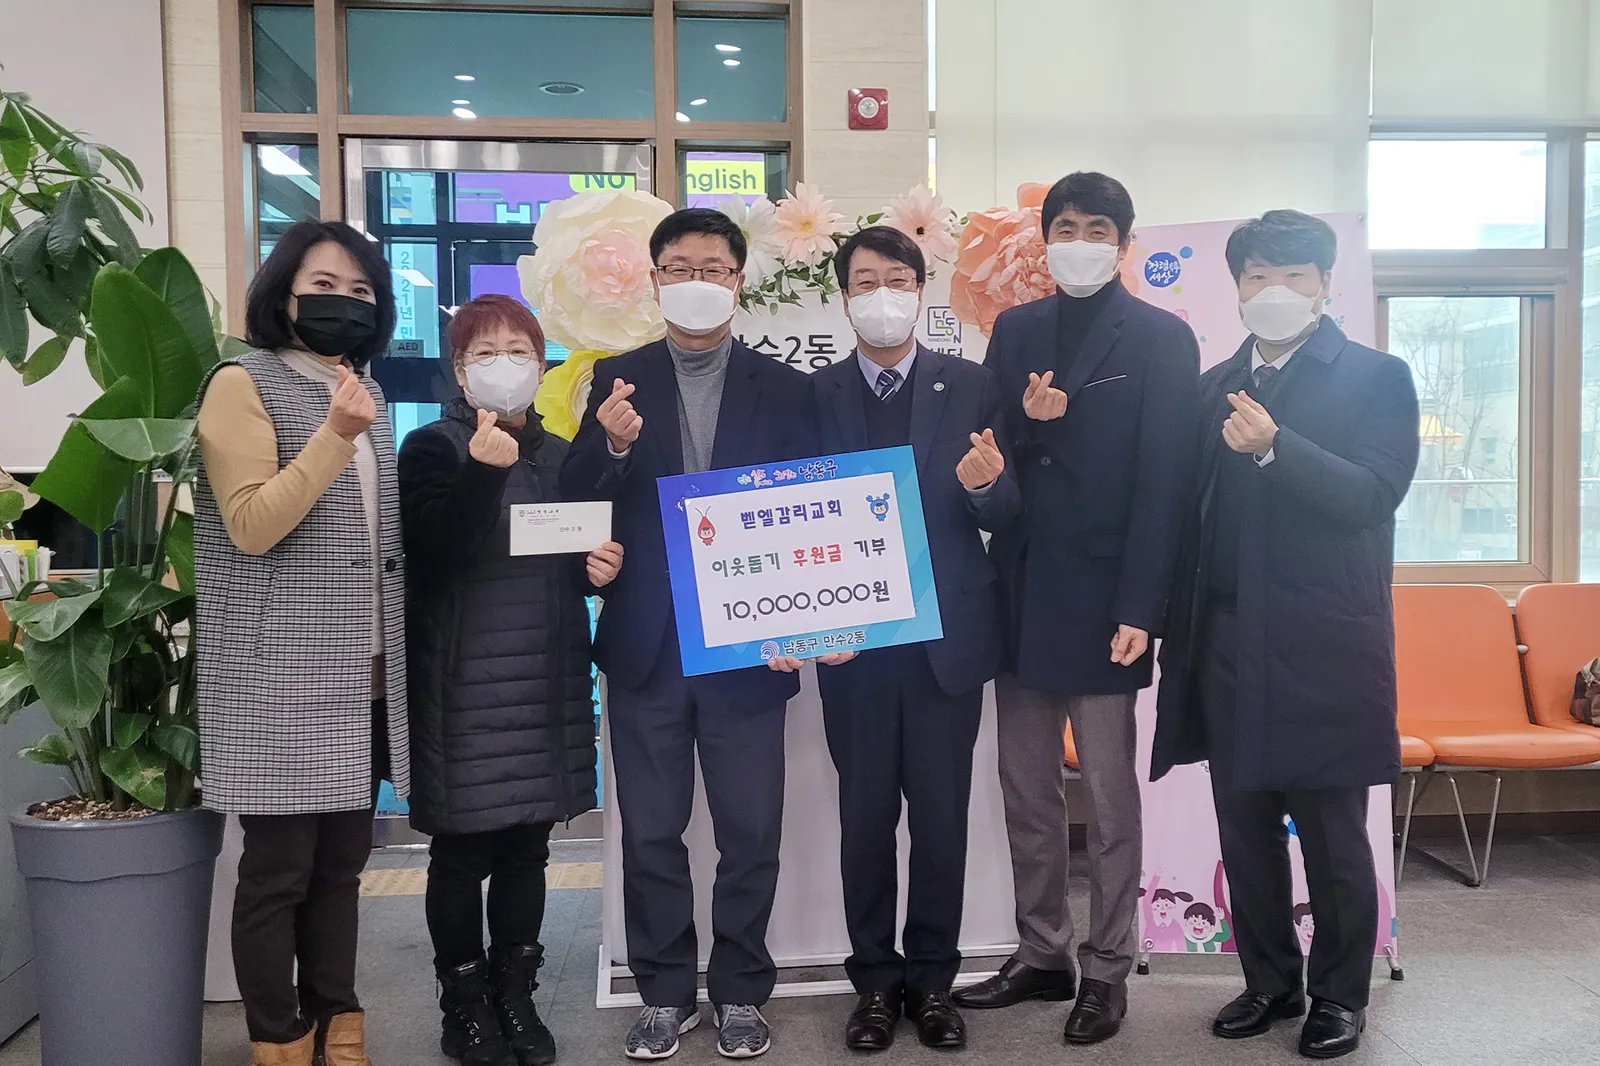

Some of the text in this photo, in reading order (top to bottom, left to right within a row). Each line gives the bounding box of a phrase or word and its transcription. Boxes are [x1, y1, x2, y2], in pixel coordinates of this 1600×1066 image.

[1149, 271, 1175, 284] 세상
[397, 342, 419, 351] AED
[799, 459, 838, 481] 남동구
[740, 499, 842, 530] 벧엘감리교회
[711, 538, 886, 578] 이웃돕기 후원금 기부
[722, 580, 891, 622] 10,000,000원
[783, 630, 866, 655] 남동구 만수2동
